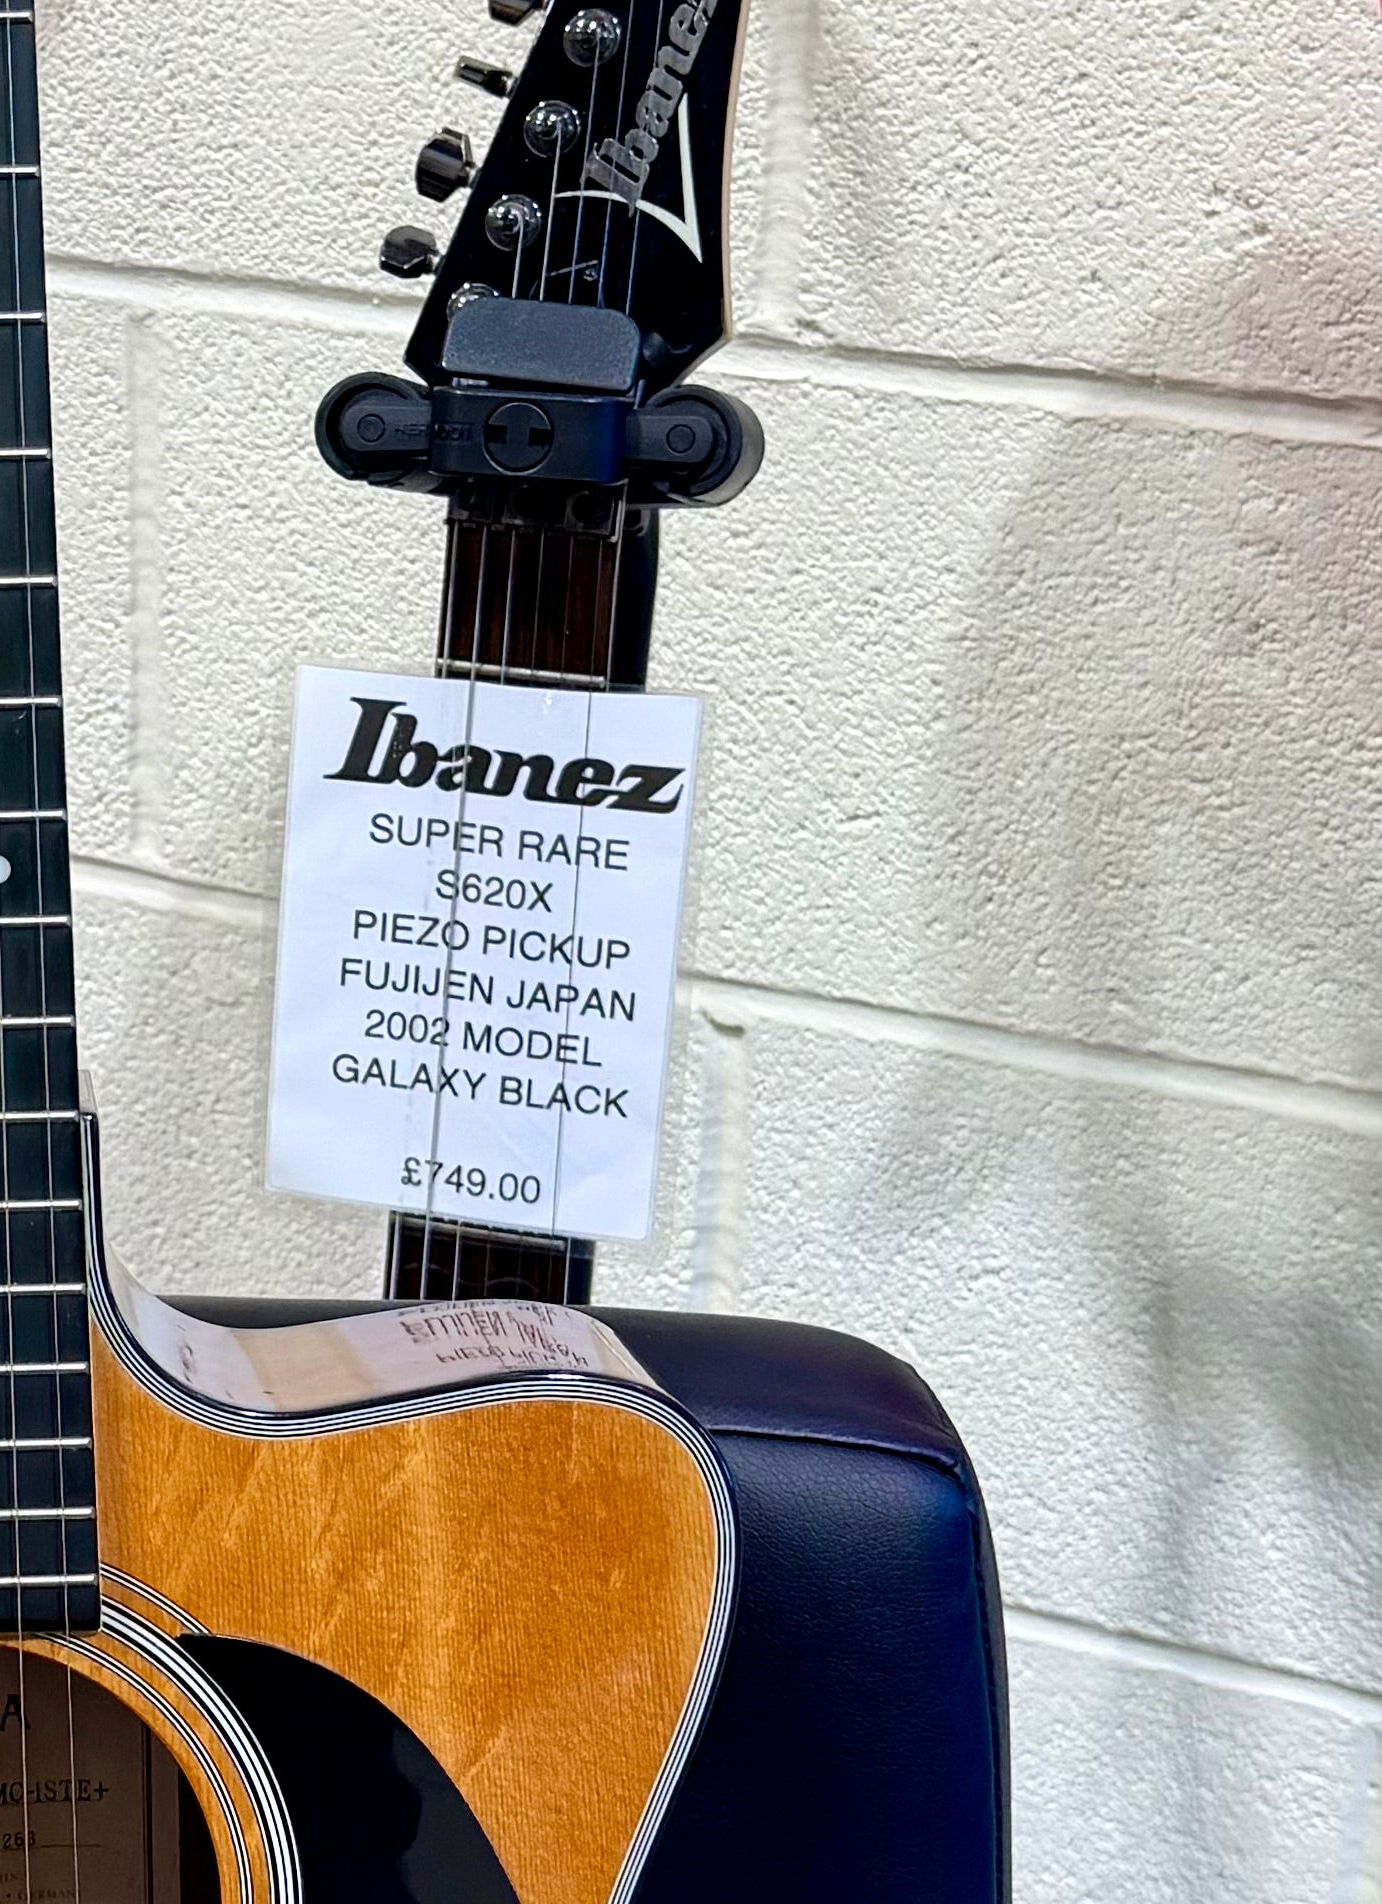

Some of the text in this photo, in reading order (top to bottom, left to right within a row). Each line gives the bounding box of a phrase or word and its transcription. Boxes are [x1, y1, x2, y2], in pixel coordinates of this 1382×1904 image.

[323, 696, 686, 815] Ibanez
[369, 812, 630, 871] SUPER RARE
[434, 870, 554, 913] S620X
[353, 909, 631, 969] PIEZO PICKUP
[340, 958, 636, 1022] FUJIJEN JAPAN
[364, 1009, 603, 1068] 2002 MODEL
[331, 1053, 629, 1119] GALAXY BLACK
[400, 1156, 542, 1204] £749.00
